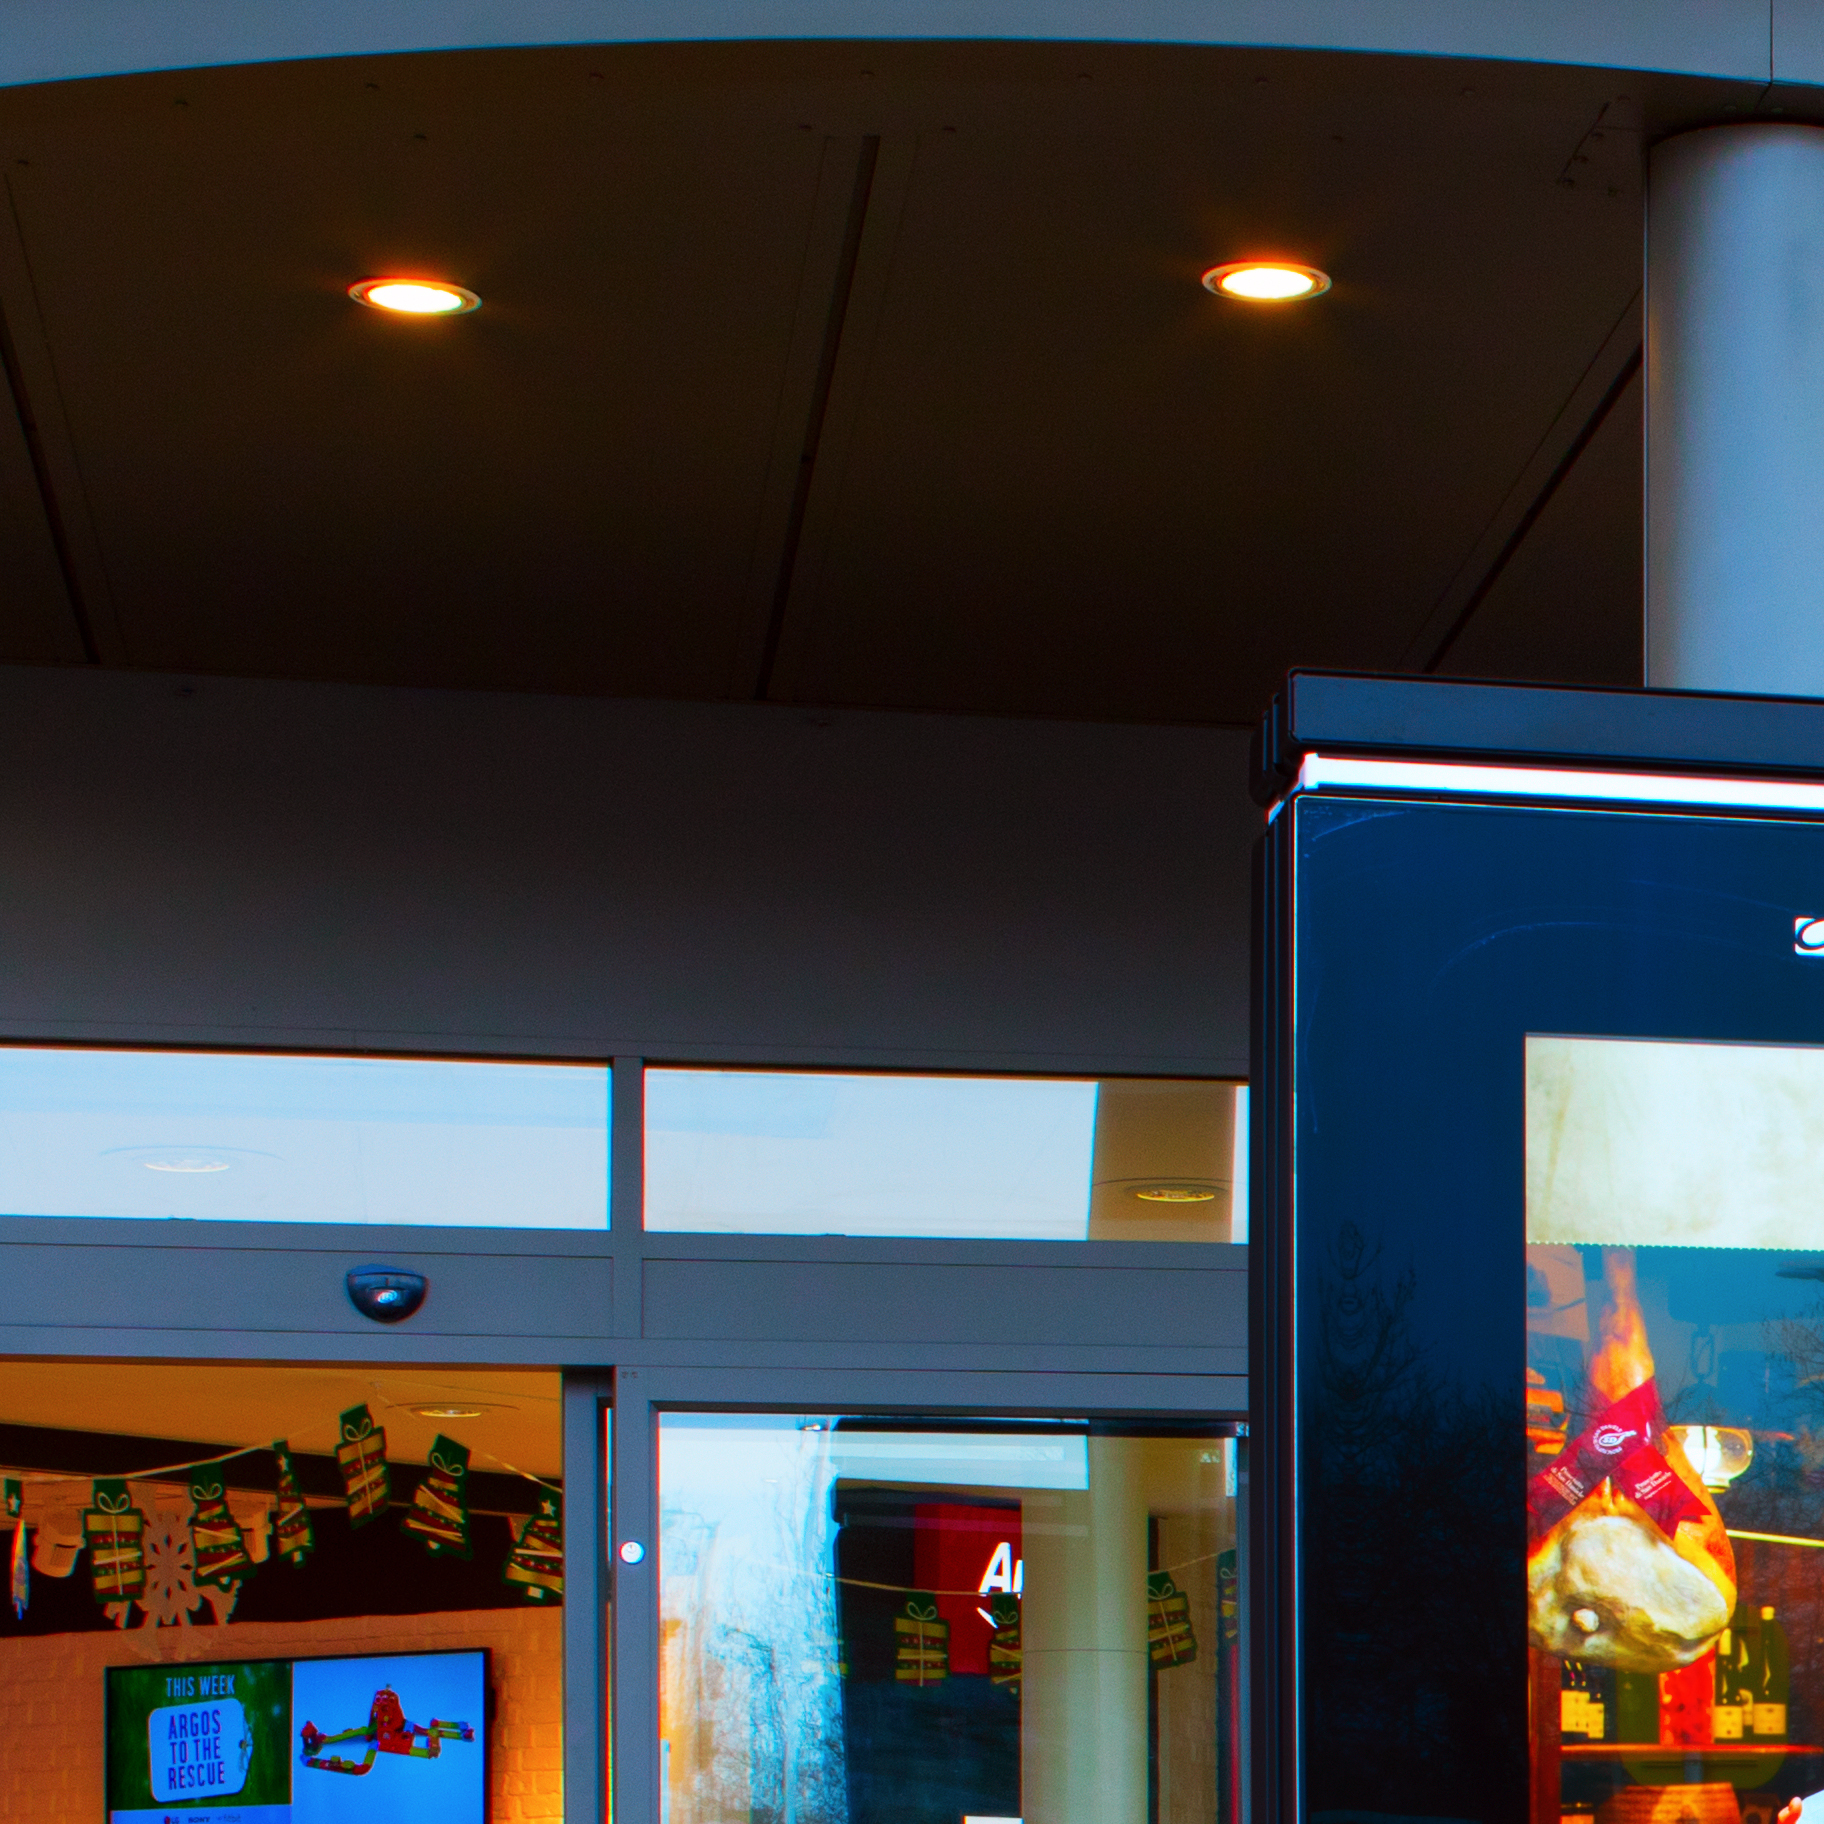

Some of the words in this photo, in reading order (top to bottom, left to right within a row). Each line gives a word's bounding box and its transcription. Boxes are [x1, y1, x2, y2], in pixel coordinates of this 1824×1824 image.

[166, 1676, 195, 1697] THIS
[199, 1674, 236, 1696] WEEK
[168, 1709, 222, 1740] ARGOS
[170, 1739, 189, 1764] TO
[193, 1736, 221, 1761] THE
[168, 1761, 226, 1790] RESCUE
